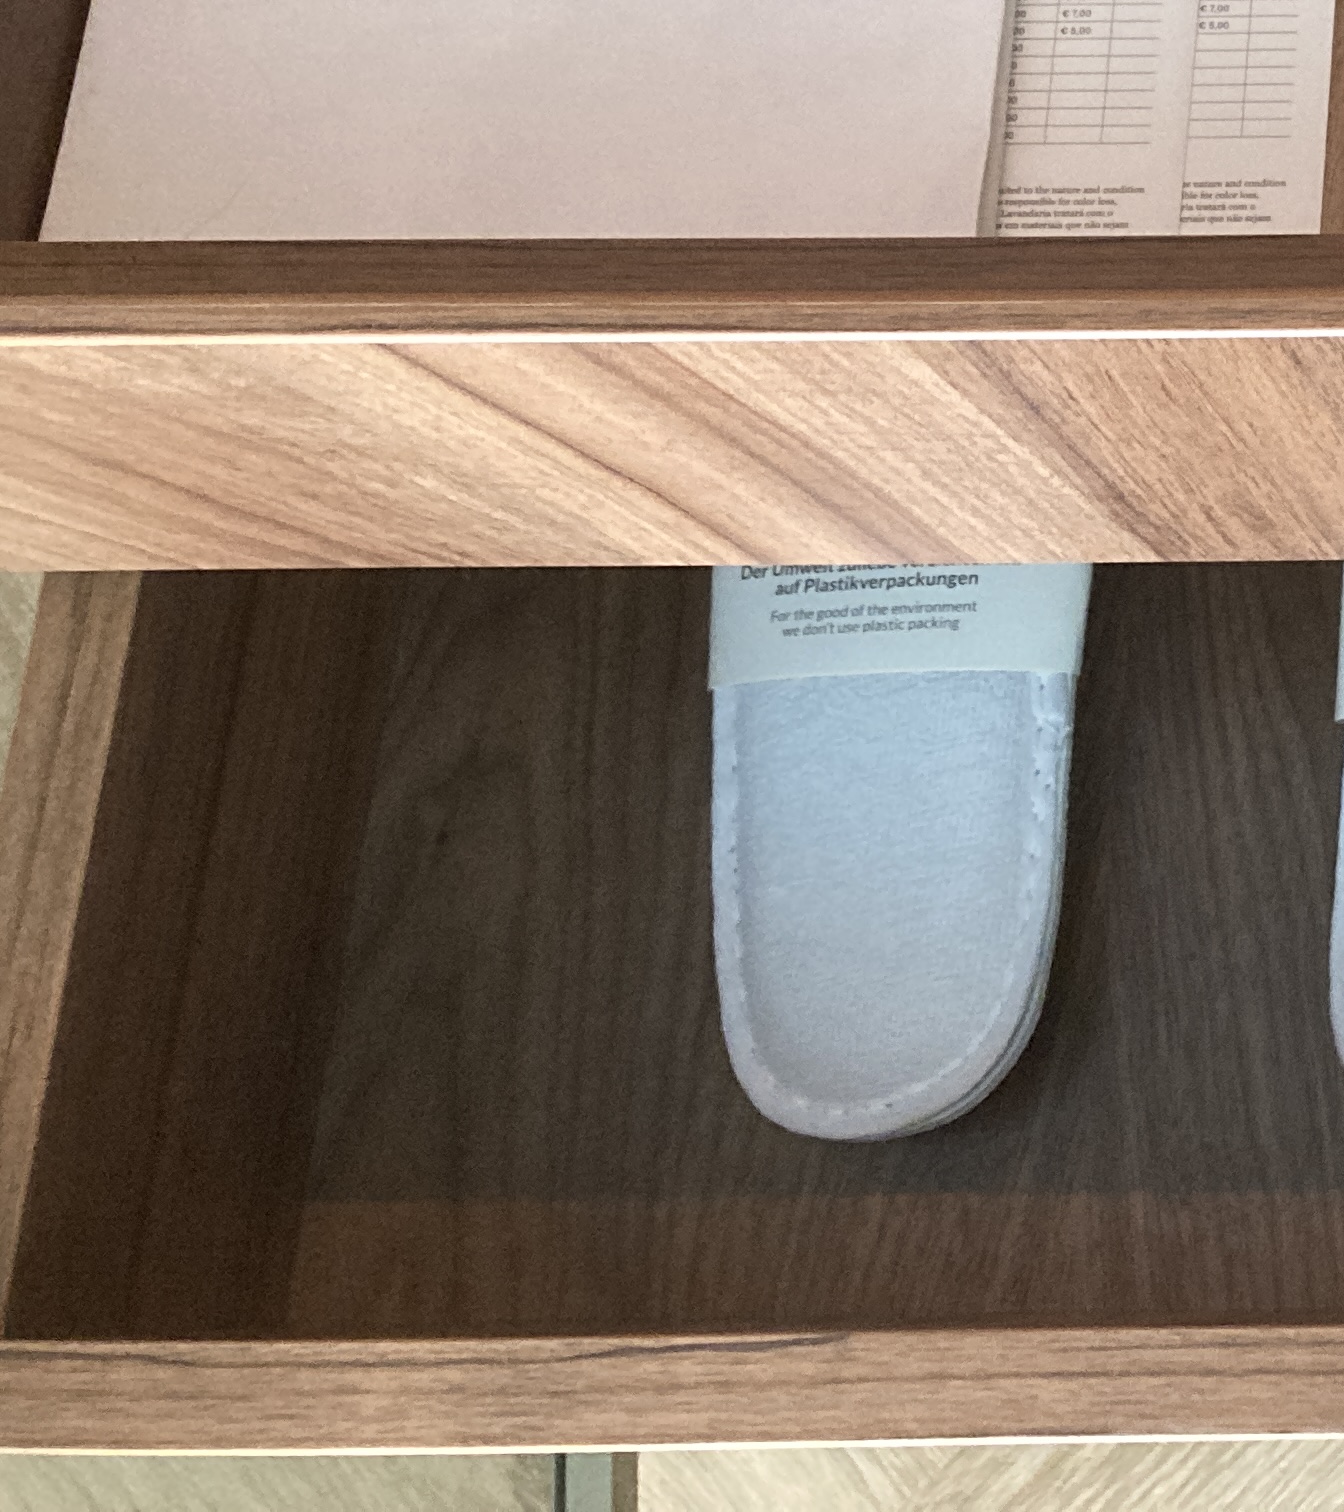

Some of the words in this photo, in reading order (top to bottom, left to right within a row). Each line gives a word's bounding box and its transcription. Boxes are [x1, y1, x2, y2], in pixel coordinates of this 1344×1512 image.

[775, 579, 804, 596] auf
[804, 571, 979, 594] Plastikverpackungen
[770, 610, 790, 622] For
[794, 608, 814, 620] the
[816, 605, 848, 622] good
[850, 604, 865, 616] of
[868, 604, 888, 616] the
[891, 601, 977, 614] environment
[783, 628, 800, 637] we
[838, 624, 861, 633] use
[863, 618, 904, 632] plastic
[908, 616, 960, 631] packing
